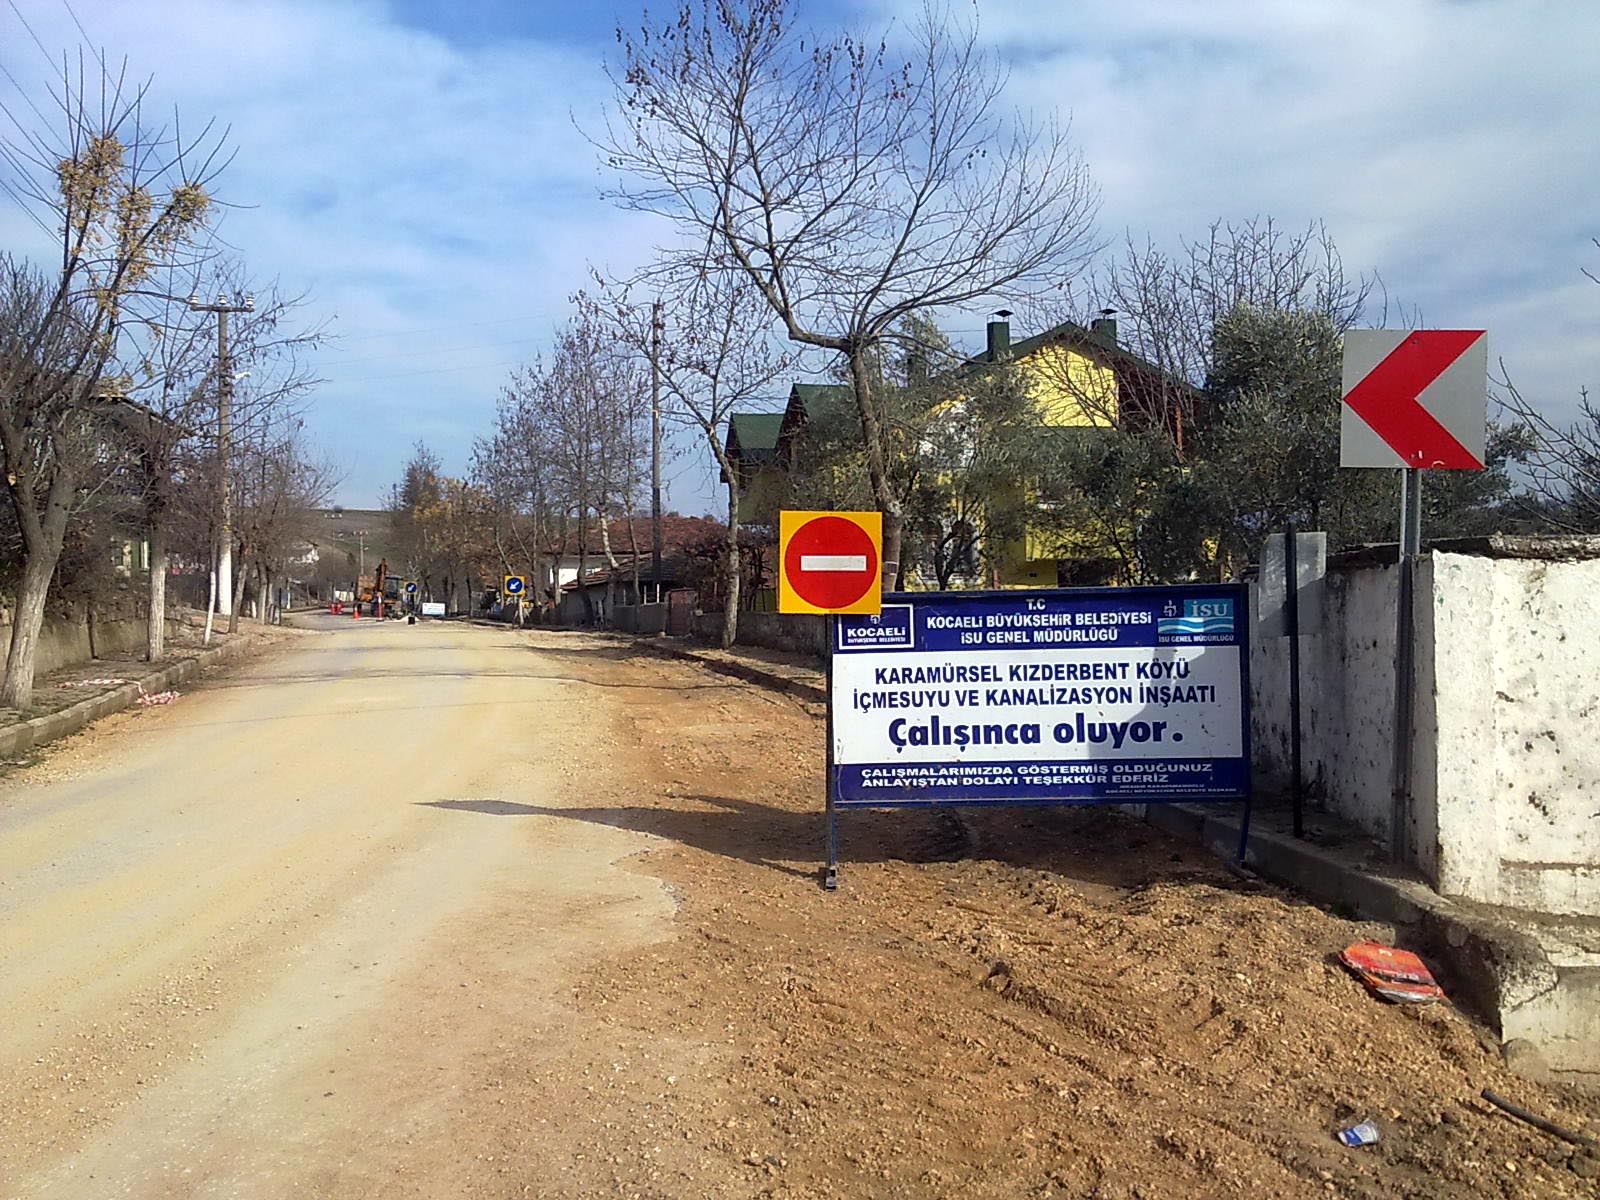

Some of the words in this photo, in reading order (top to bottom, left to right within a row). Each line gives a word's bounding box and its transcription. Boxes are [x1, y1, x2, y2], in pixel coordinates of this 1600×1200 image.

[986, 630, 1030, 644] GENEL
[875, 663, 1003, 684] KARAMÜRSEL
[1009, 663, 1130, 682] KIZDERBENT
[1136, 658, 1190, 680] KÖYÜ
[853, 688, 950, 713] İÇMESUYU
[955, 690, 979, 706] VE
[985, 684, 1132, 706] KANALİZASYON
[1139, 682, 1216, 707] İNŞAATI
[888, 715, 1041, 753] Çalışınca
[861, 767, 1013, 778] ÇALIŞMALARIMIZDA
[1113, 763, 1212, 773] OLDUĞUNUZ
[861, 778, 958, 788] ANLAYIŞTAN
[962, 777, 1018, 786] DOLAYI
[1022, 774, 1107, 785] TEŞEKKÜR
[1112, 773, 1168, 783] EDERİZ
